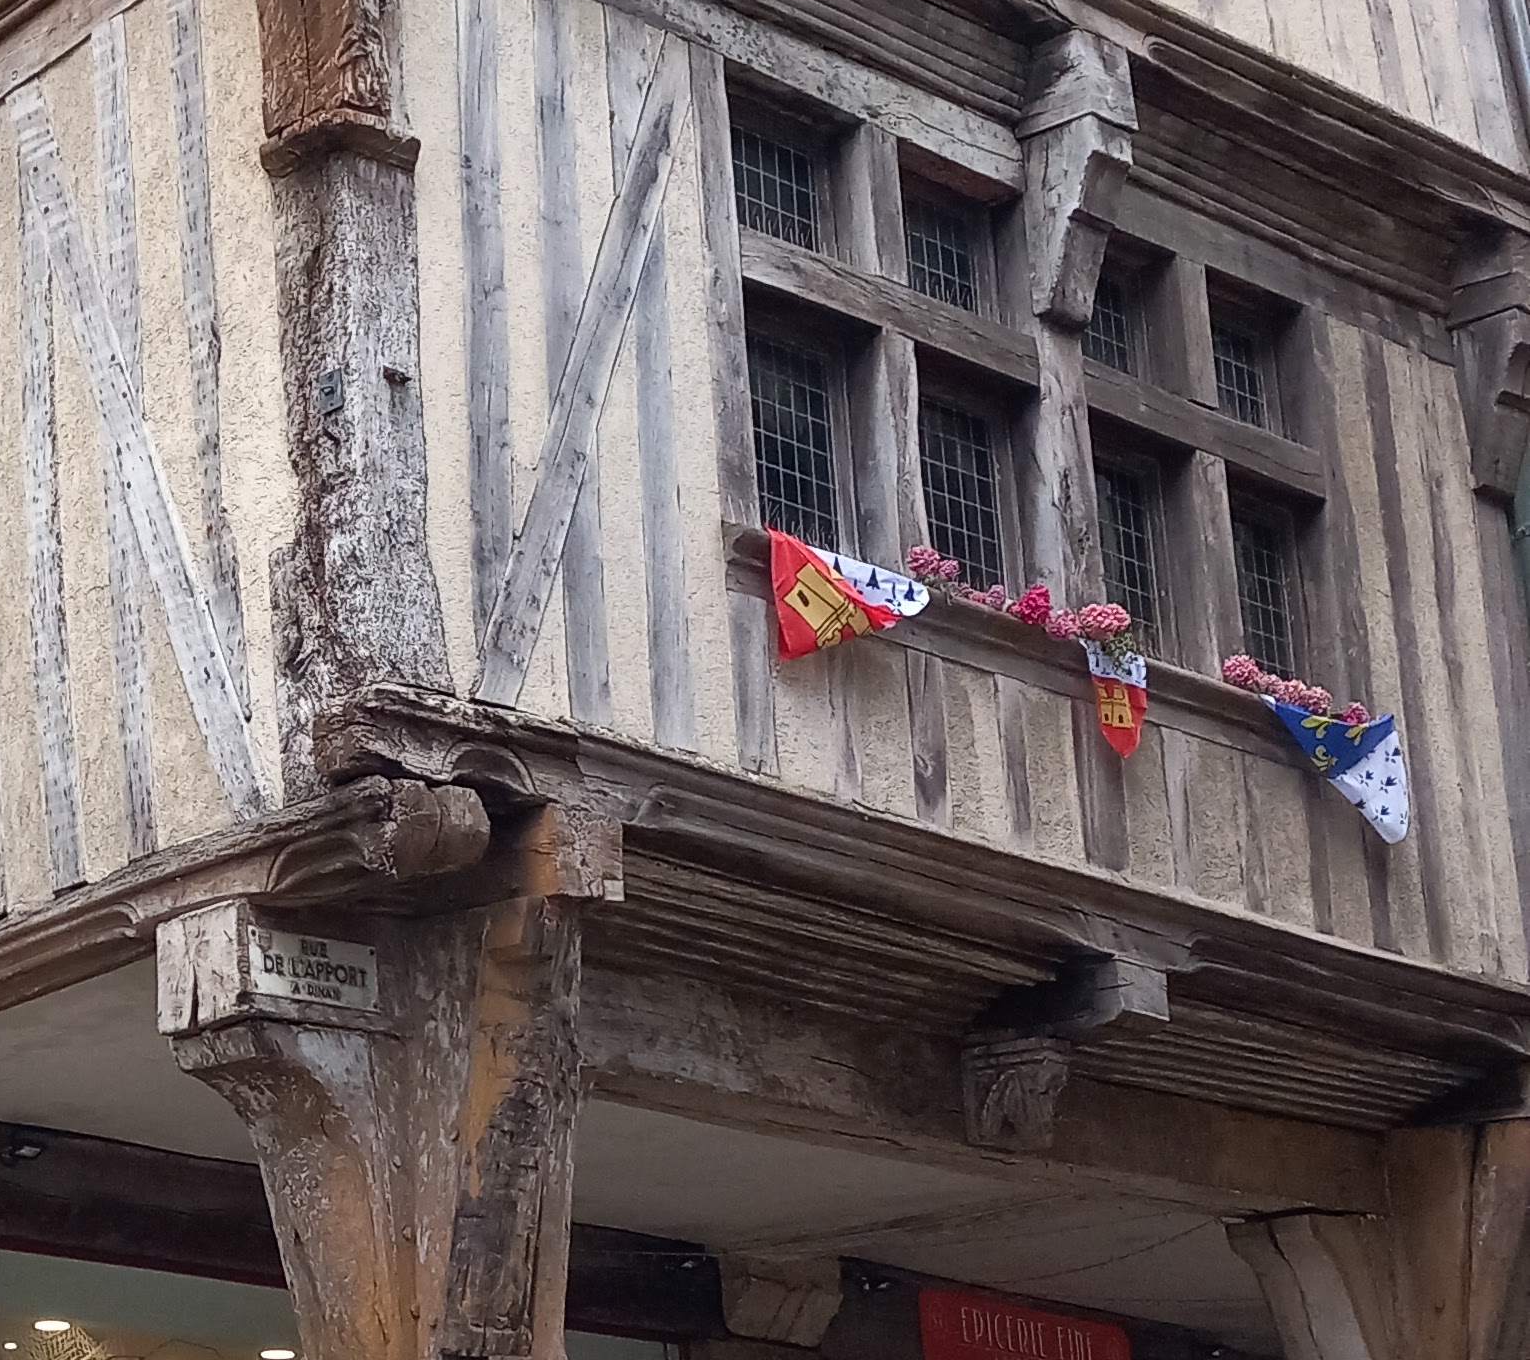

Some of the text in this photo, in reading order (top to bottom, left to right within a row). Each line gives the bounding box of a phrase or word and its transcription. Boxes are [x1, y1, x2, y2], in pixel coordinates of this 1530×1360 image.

[301, 939, 329, 958] RUE
[263, 954, 367, 987] DE L'APPORT
[307, 983, 341, 1000] DINAN
[960, 1306, 1047, 1358] EPICERIE
